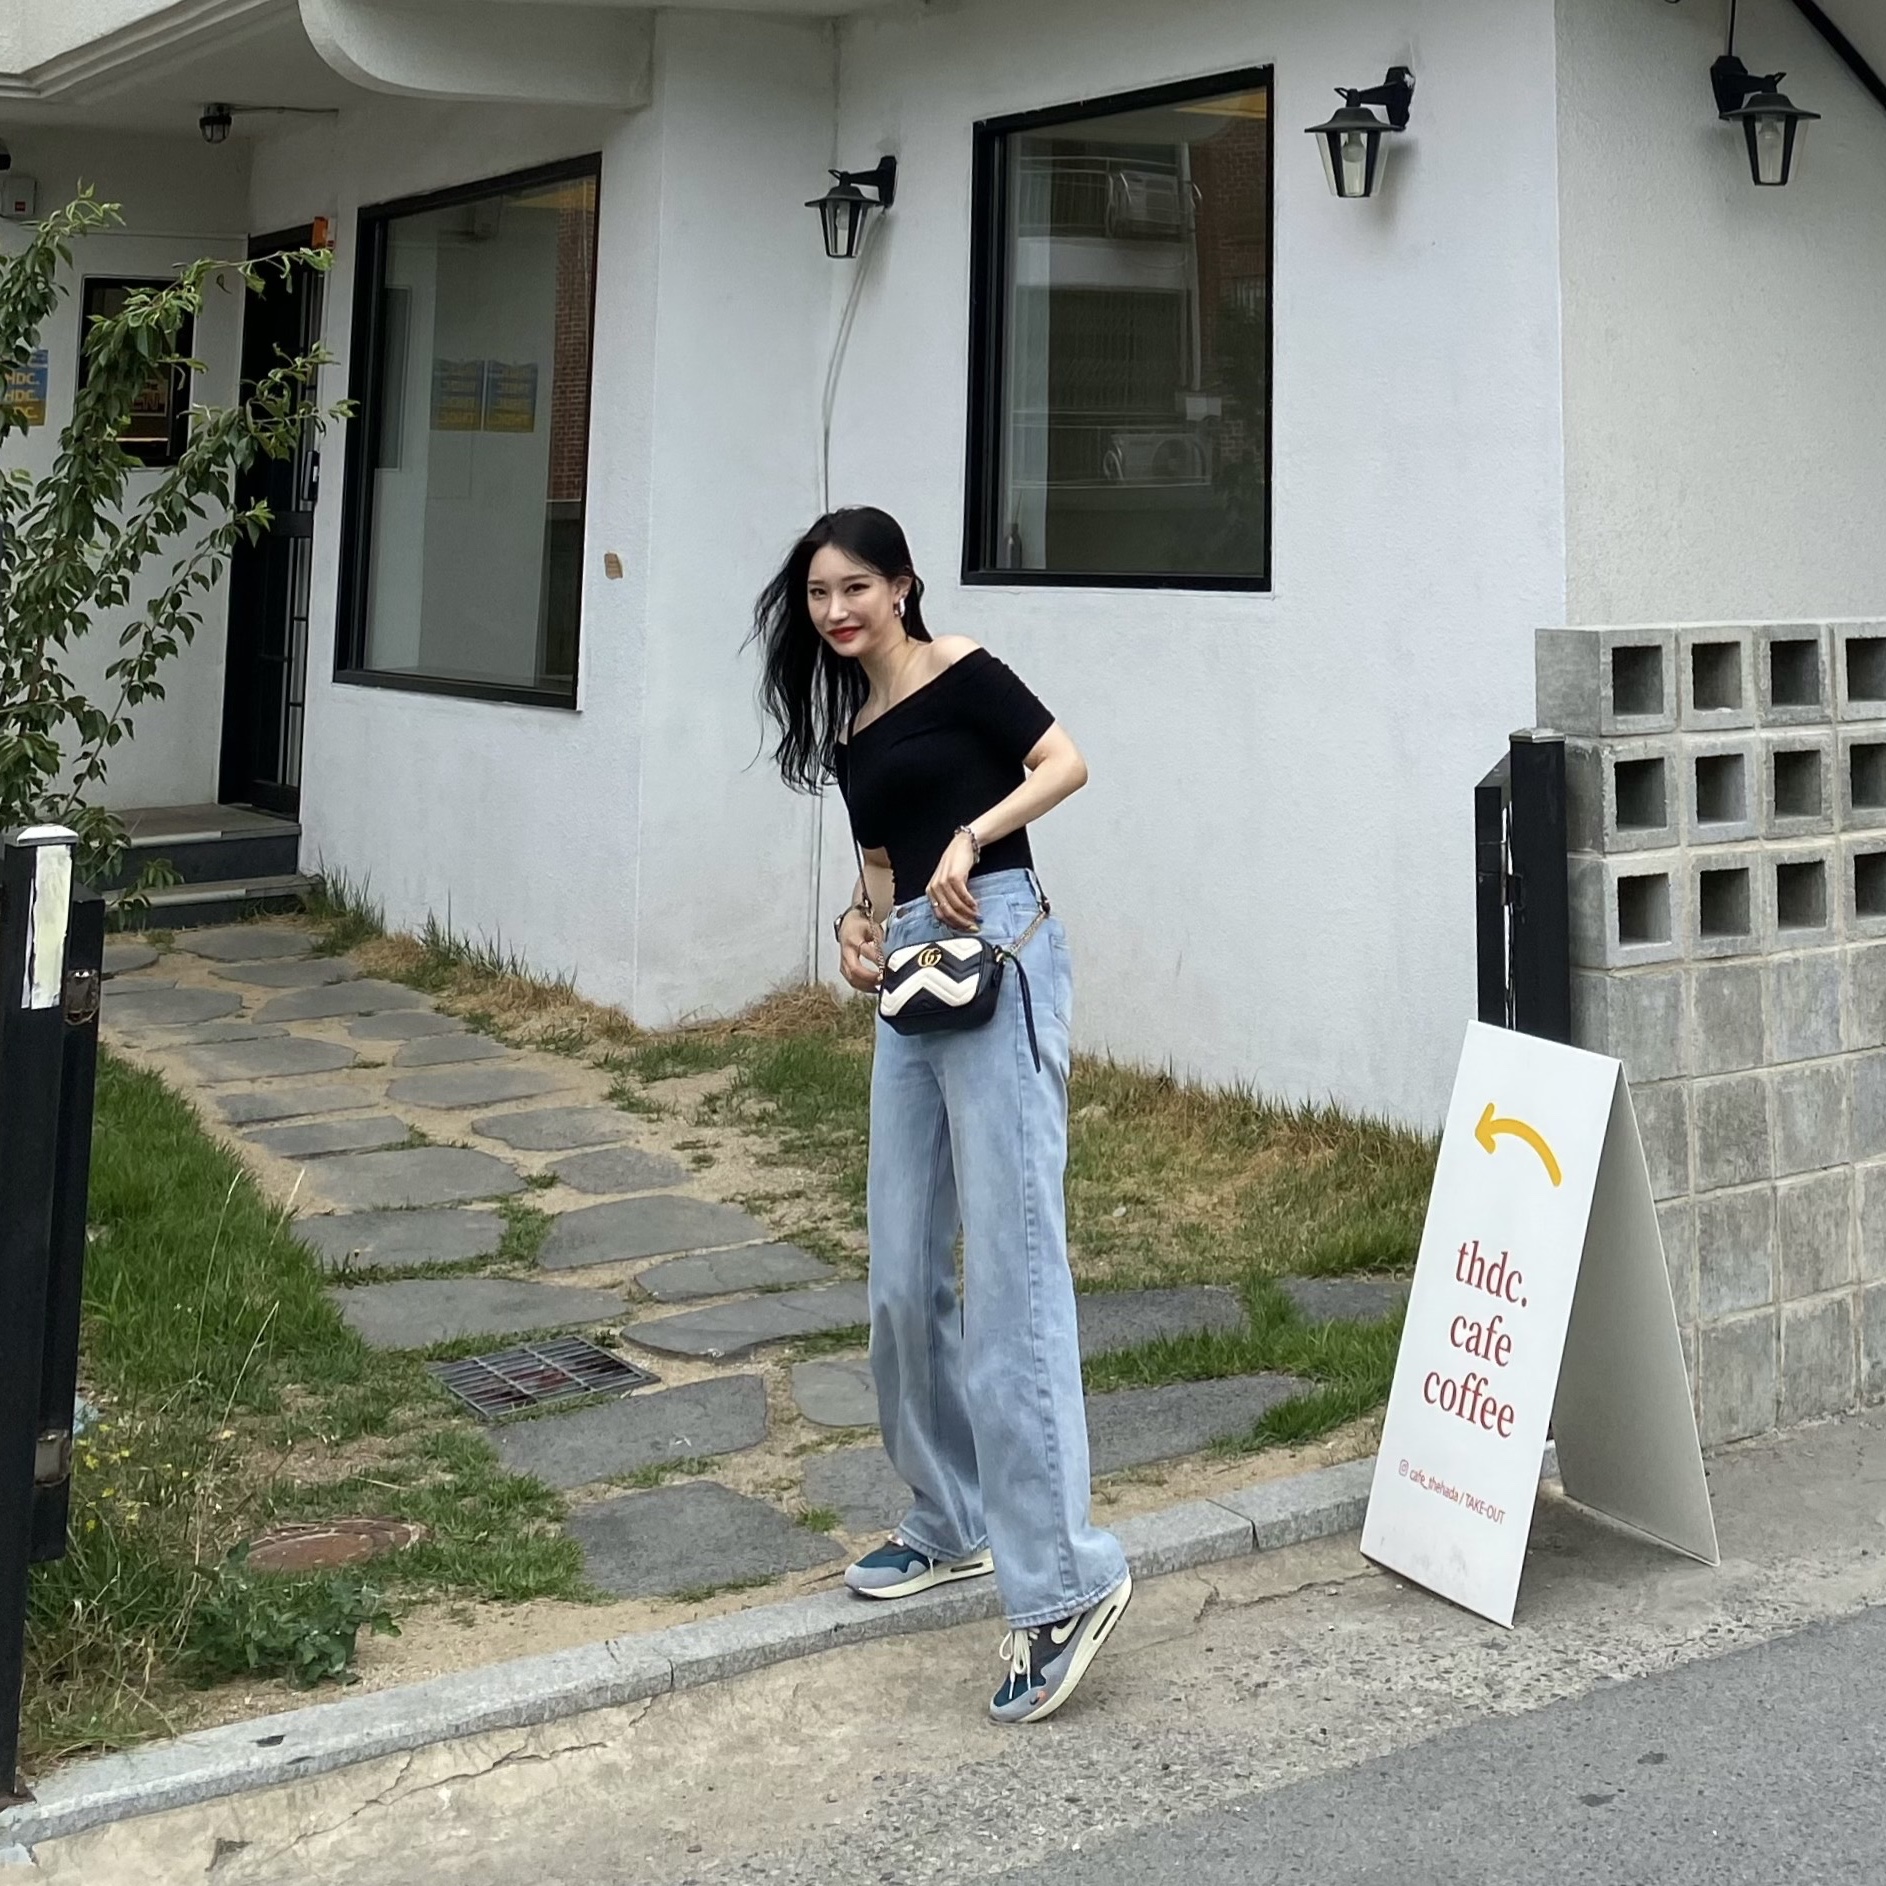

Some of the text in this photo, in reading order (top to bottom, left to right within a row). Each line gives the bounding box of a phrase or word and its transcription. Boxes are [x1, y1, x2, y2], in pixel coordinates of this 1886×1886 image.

[1455, 1240, 1527, 1307] thdc.
[1450, 1315, 1512, 1367] cafe
[1423, 1371, 1515, 1438] coffee
[1465, 1493, 1506, 1525] TAKE-OUT
